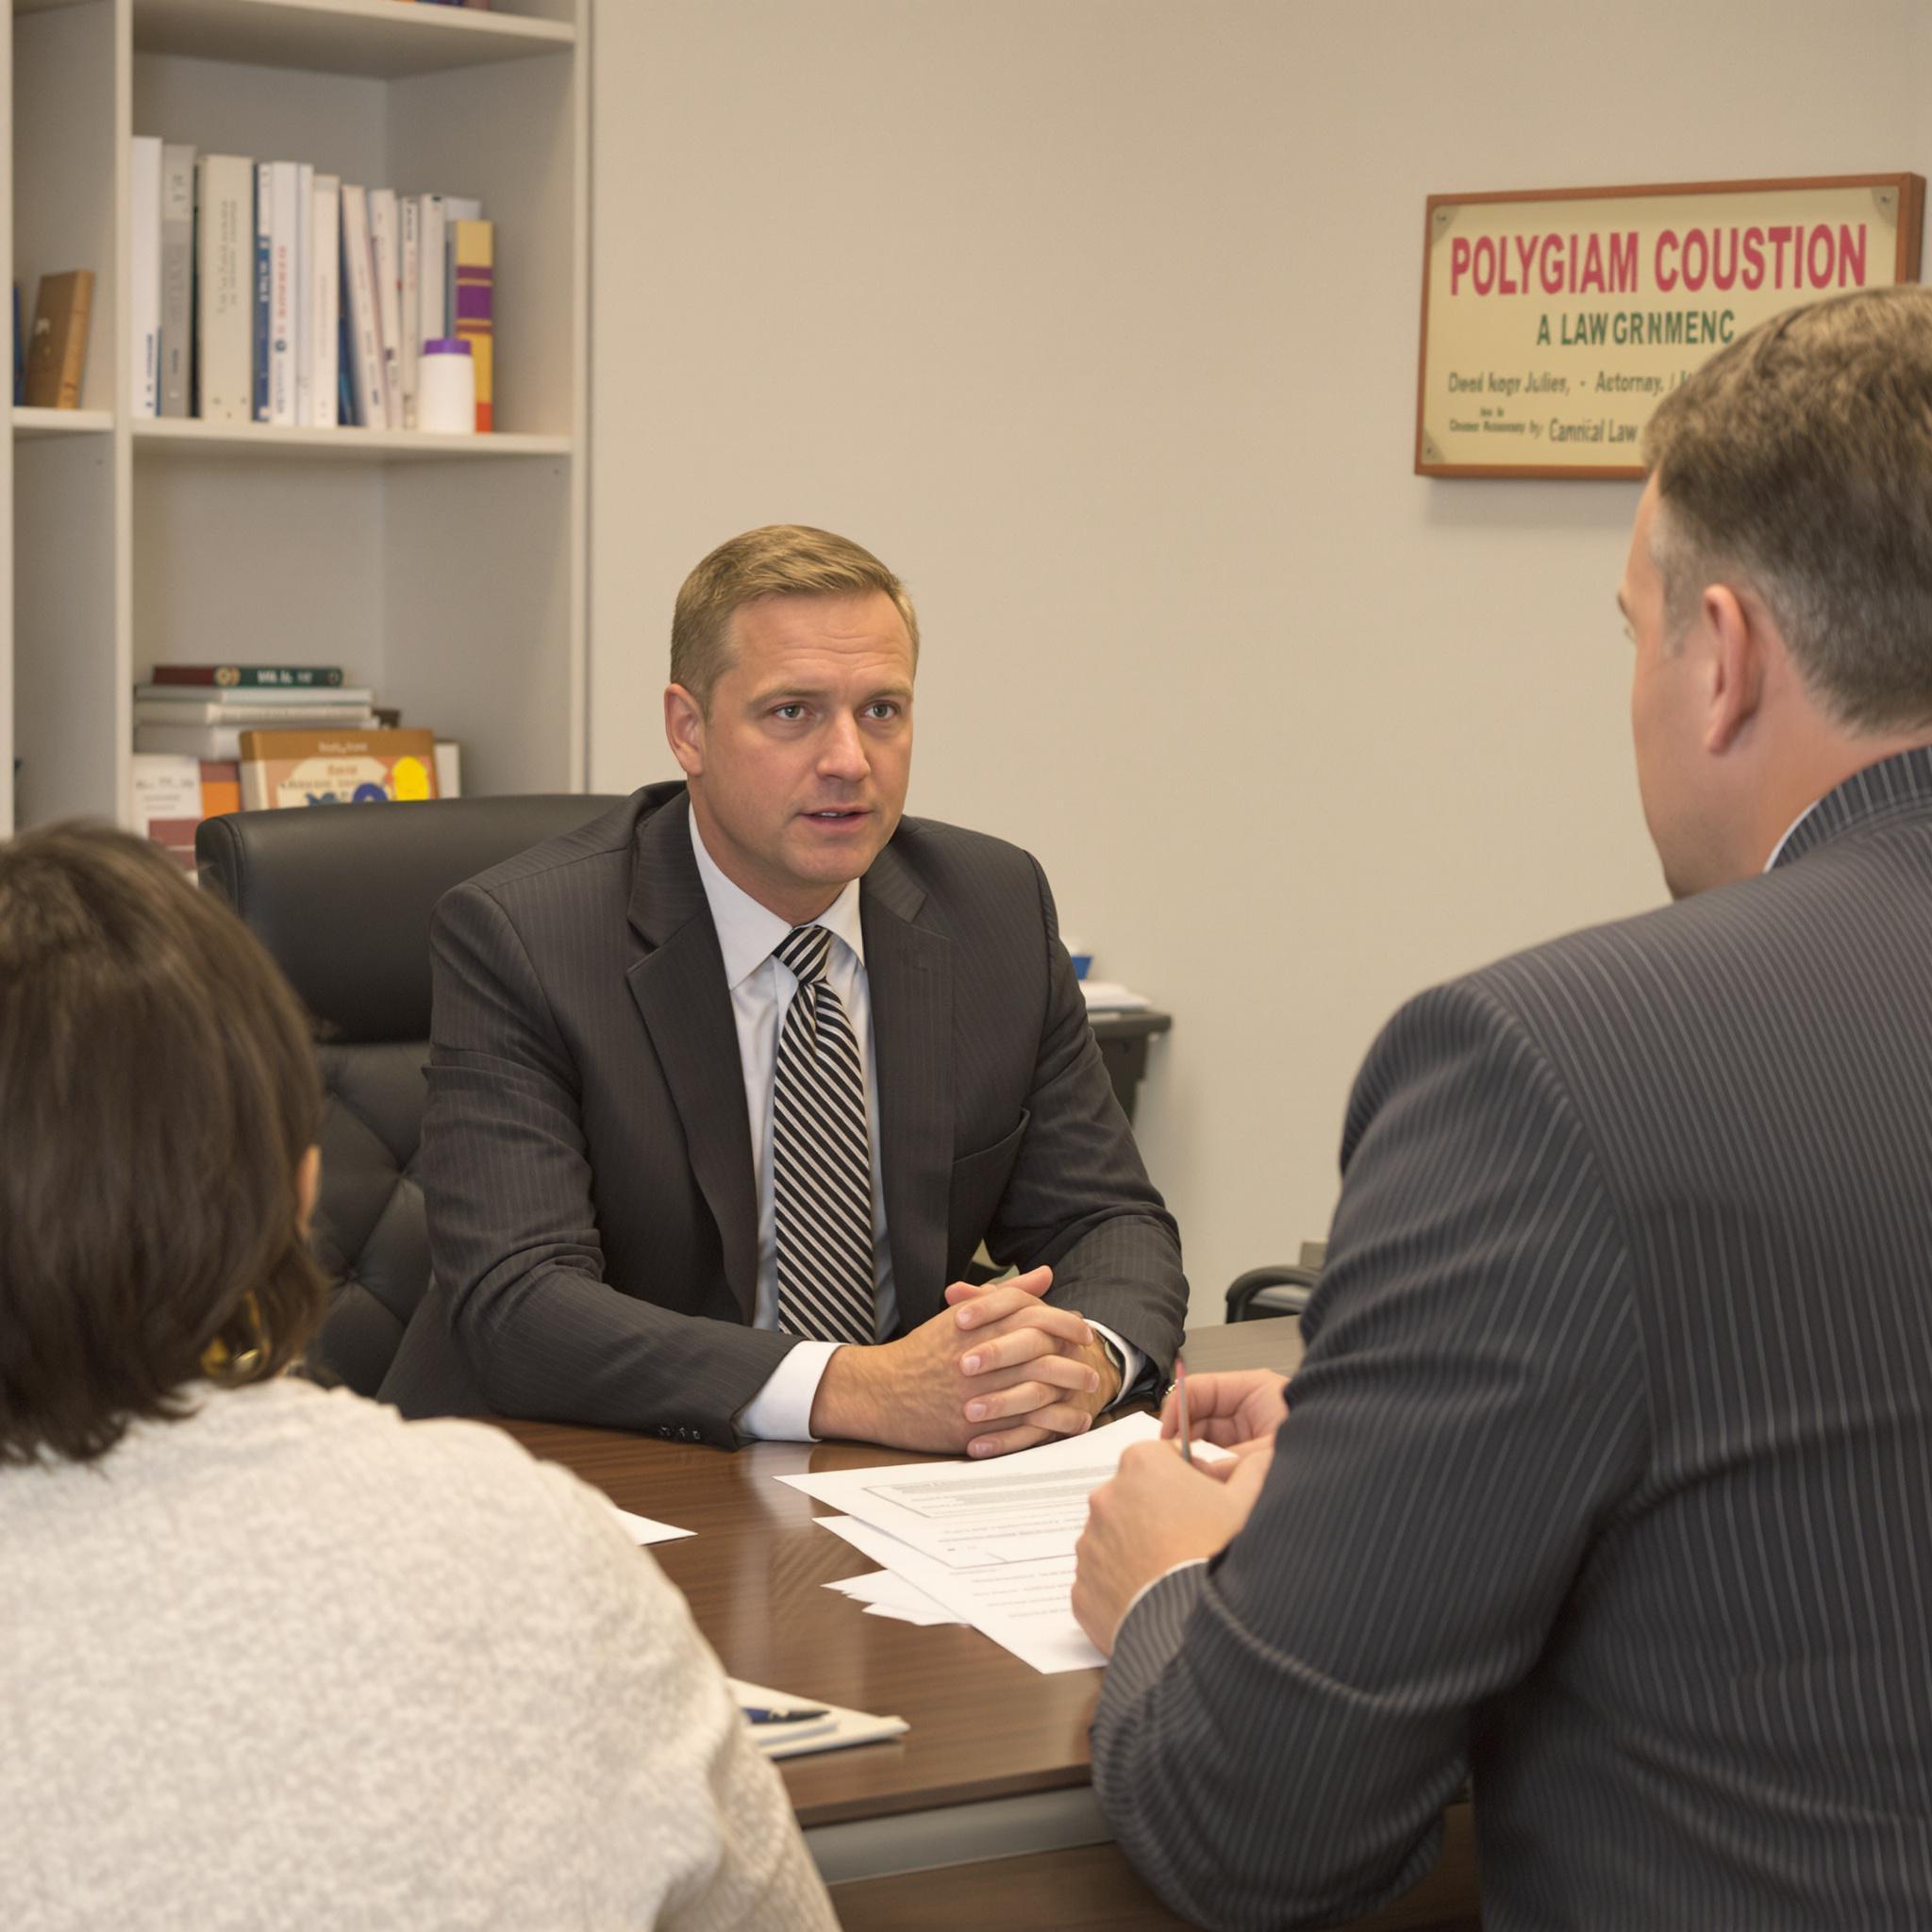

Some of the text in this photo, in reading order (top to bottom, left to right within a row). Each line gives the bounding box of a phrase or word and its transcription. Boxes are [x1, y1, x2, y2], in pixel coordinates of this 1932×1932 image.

[1449, 224, 1867, 296] POLYGIAM COUSTION
[1536, 313, 1552, 345] A
[1607, 422, 1638, 443] Law
